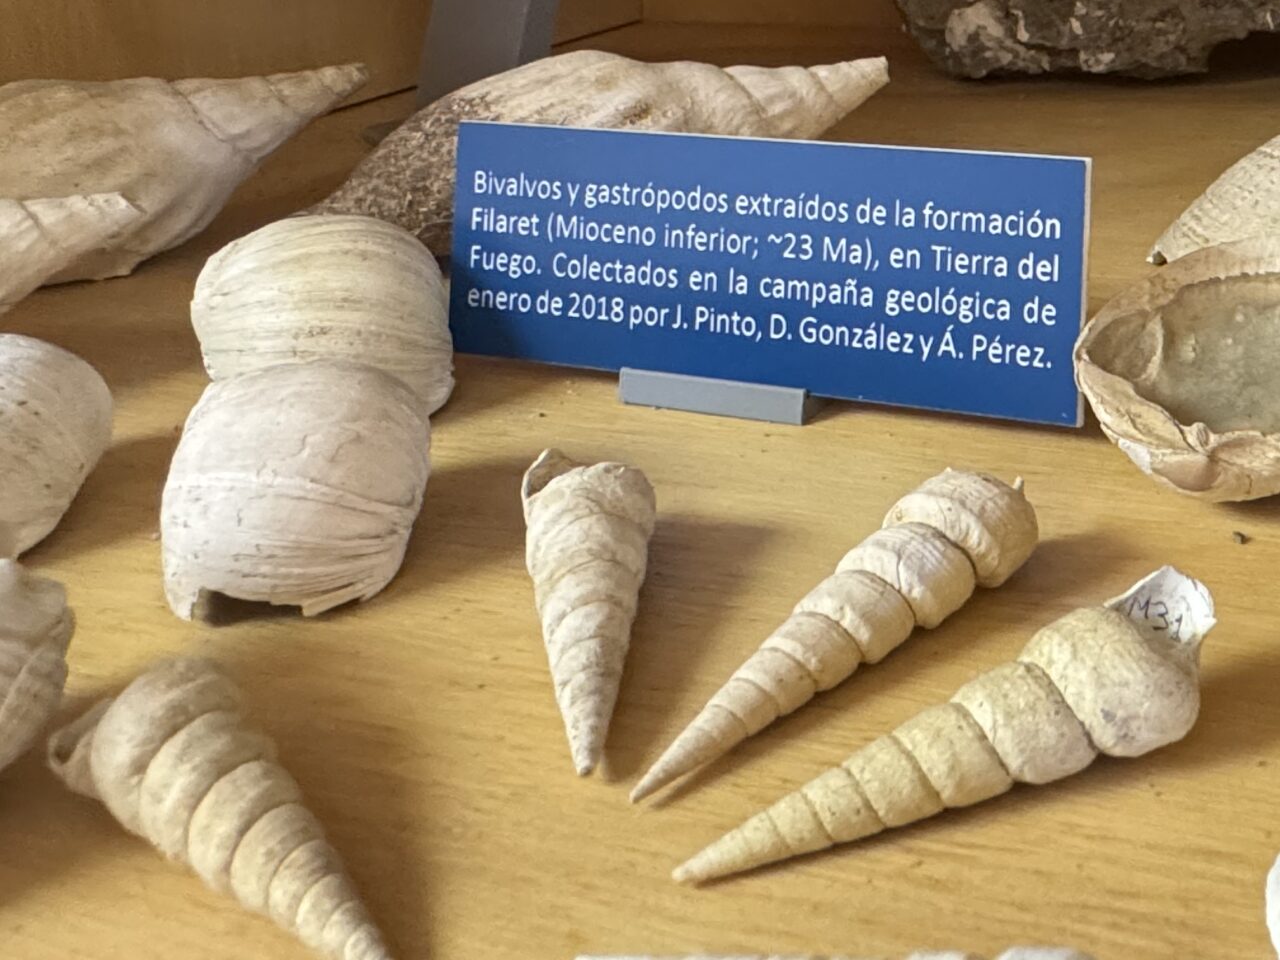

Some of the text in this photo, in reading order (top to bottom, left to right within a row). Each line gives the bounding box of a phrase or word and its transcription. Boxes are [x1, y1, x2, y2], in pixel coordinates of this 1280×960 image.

[474, 170, 1061, 240] Bivalvos y gastrópodos extraídos de la formación
[471, 207, 1059, 282] Filaret (Mioceno inferior; ~23 Ma), en Tierra del
[470, 244, 1057, 326] Fuego. Colectados en la campaña geológica de
[467, 288, 1052, 369] enero de 2018 por J. Pinto, D. González y Á. Pérez.
